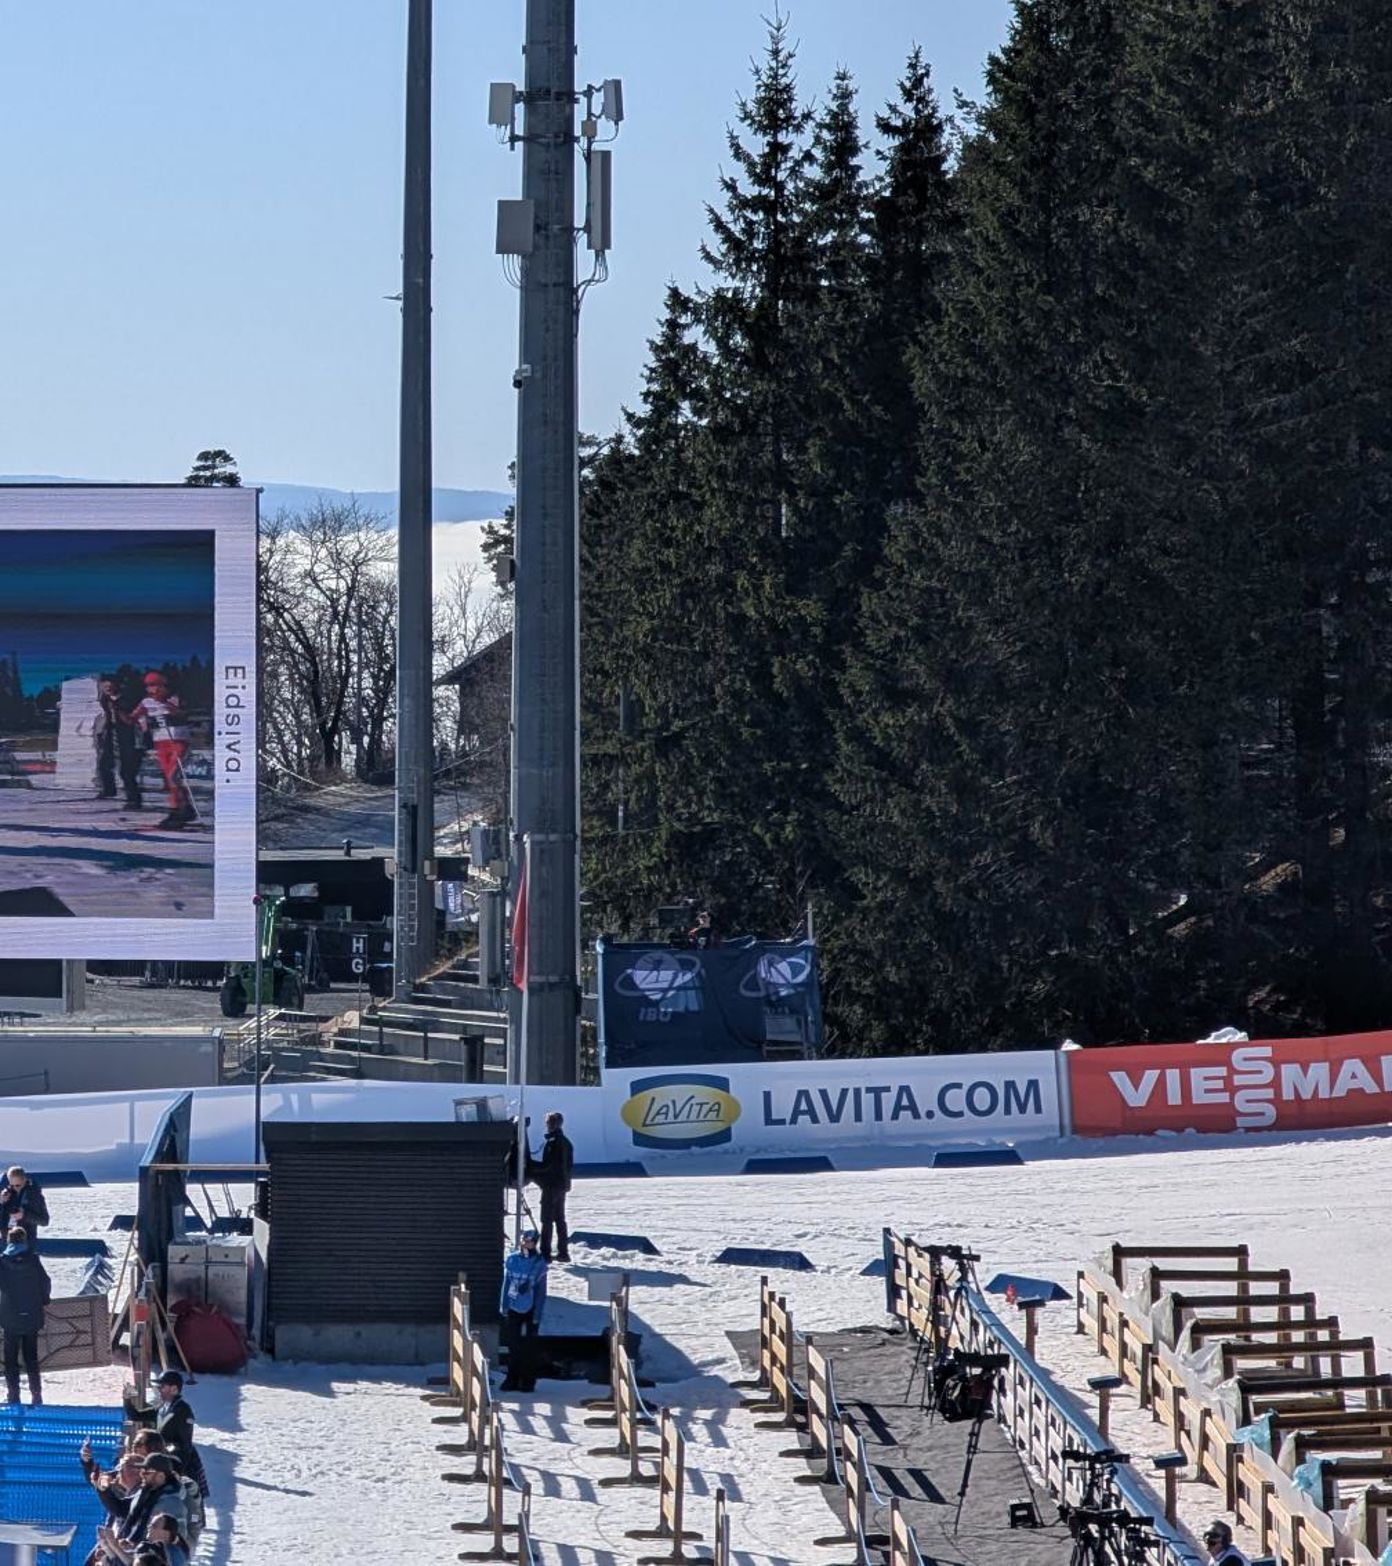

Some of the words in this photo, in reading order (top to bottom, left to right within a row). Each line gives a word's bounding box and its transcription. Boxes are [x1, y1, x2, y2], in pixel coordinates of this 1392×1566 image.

[217, 665, 247, 784] Eidsiva.
[351, 957, 364, 973] G
[352, 937, 364, 954] H
[762, 1078, 1043, 1127] LAVITA.COM
[1109, 1046, 1392, 1128] VIESSMA
